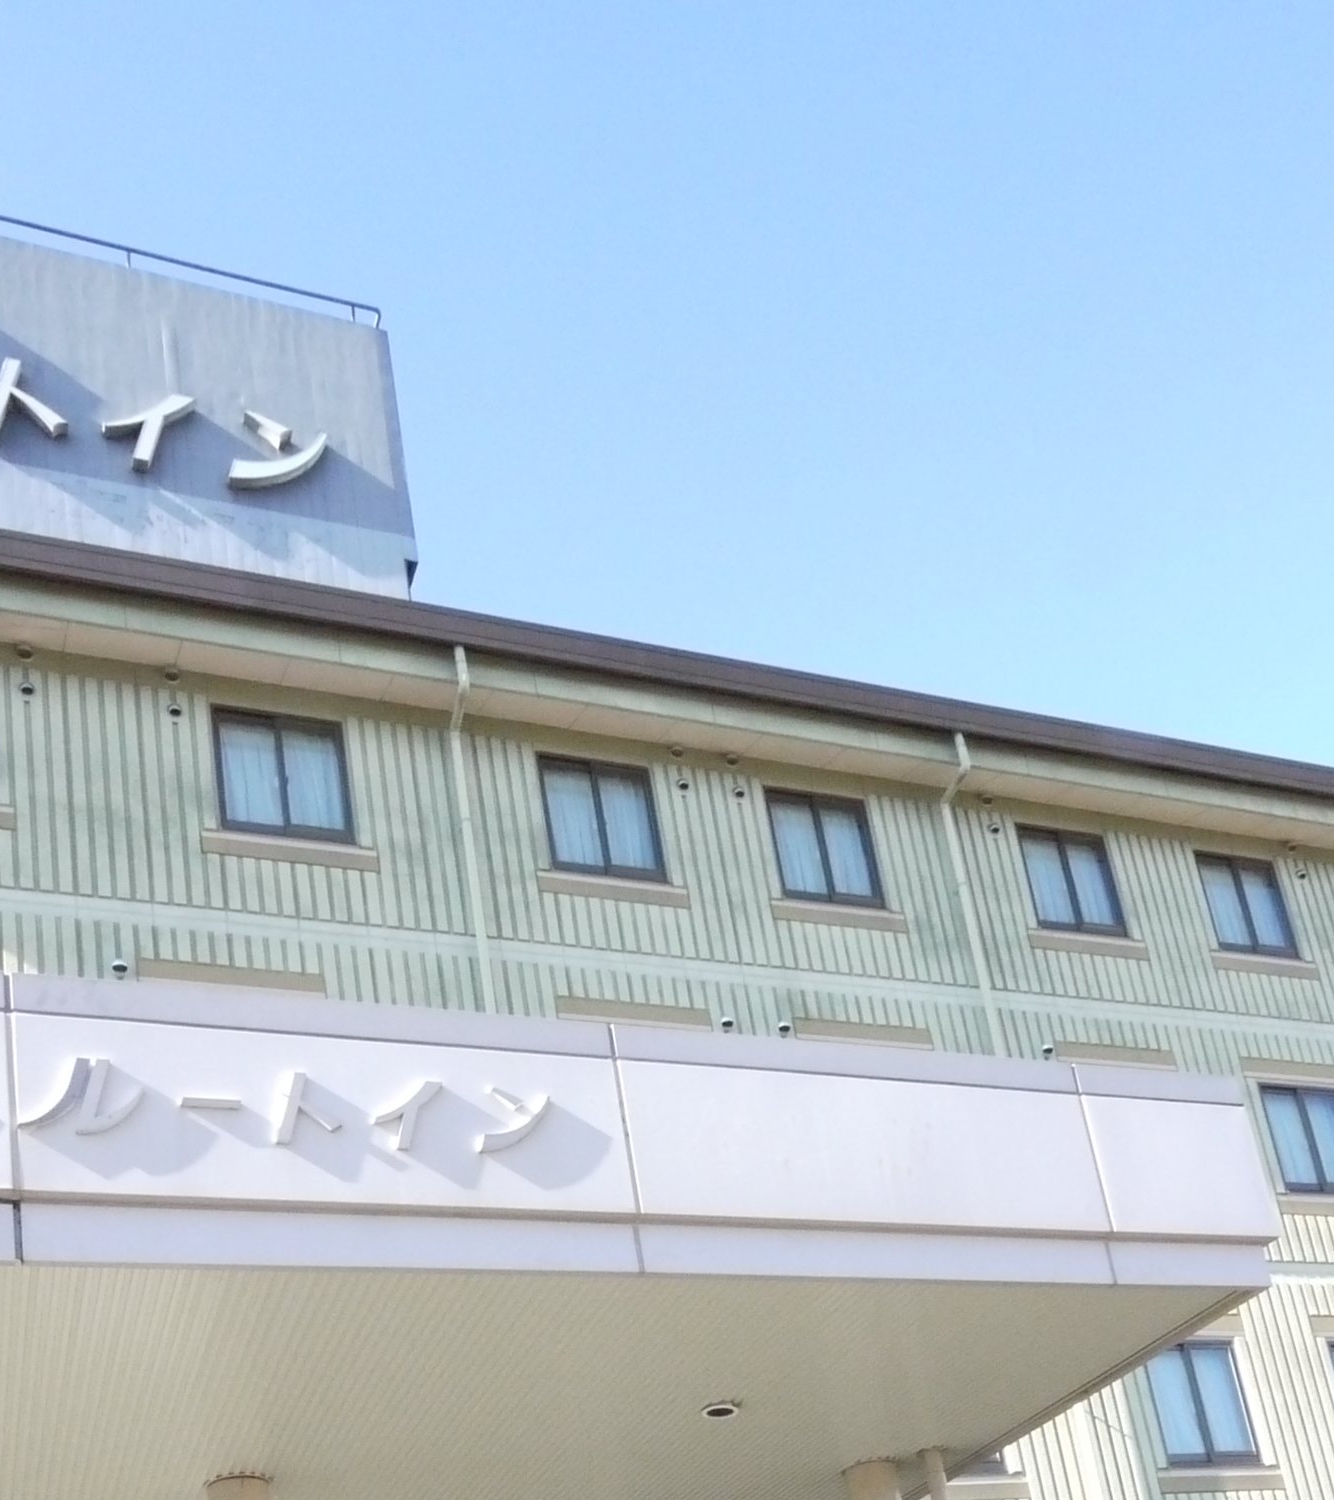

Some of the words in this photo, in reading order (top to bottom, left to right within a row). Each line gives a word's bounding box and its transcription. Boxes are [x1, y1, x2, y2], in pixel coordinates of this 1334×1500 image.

[17, 1056, 552, 1154] ルートイン
